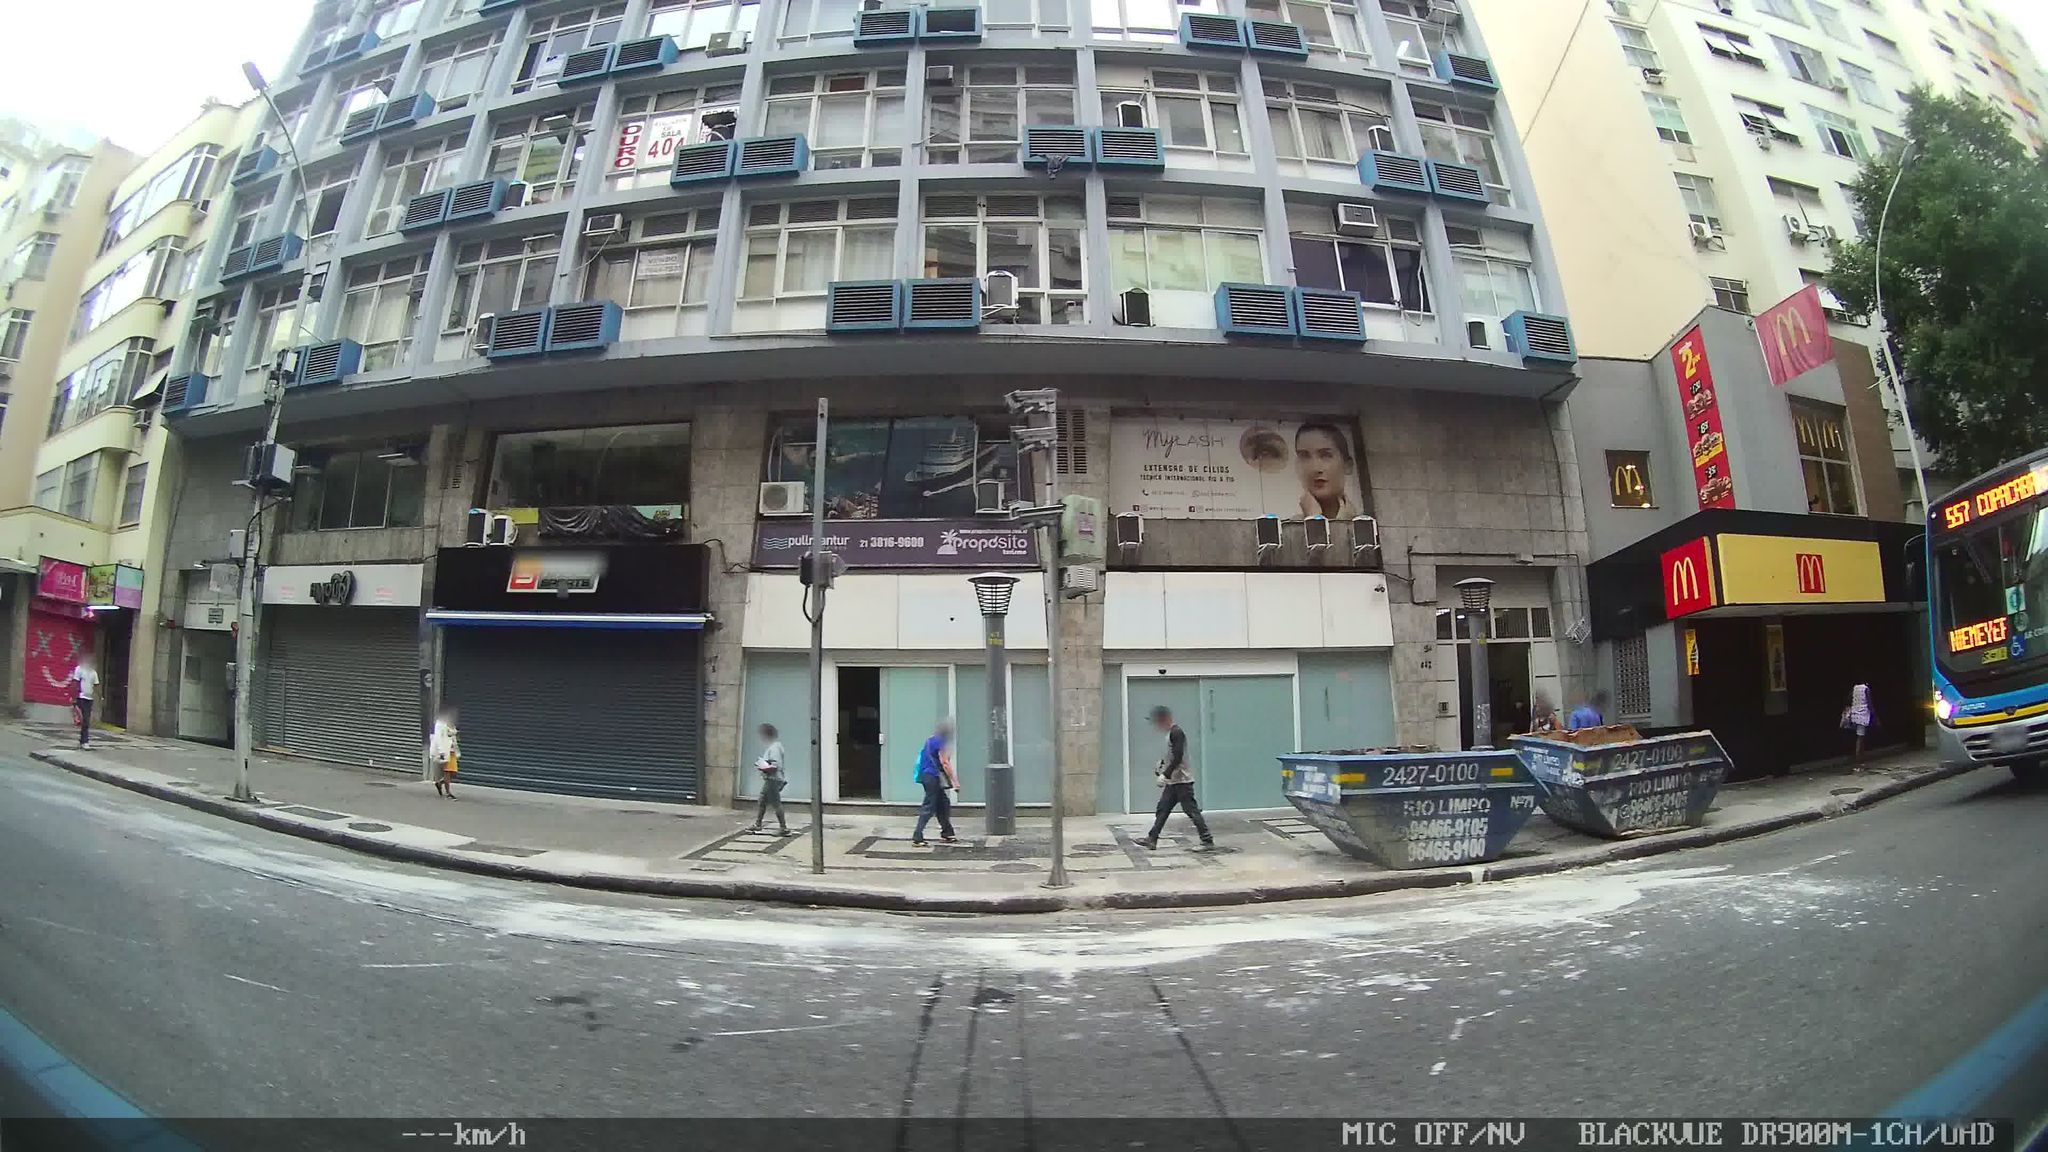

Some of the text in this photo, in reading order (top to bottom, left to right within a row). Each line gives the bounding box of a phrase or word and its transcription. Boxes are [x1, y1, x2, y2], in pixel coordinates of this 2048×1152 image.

[614, 124, 643, 168] OURO
[1945, 468, 2048, 529] 557 COPACABA
[859, 539, 868, 548] 21
[541, 578, 590, 588] SPRTS
[1614, 744, 1683, 770] 2427-0100
[1381, 763, 1480, 787] 2427-0100
[1438, 797, 1491, 815] LIMPO
